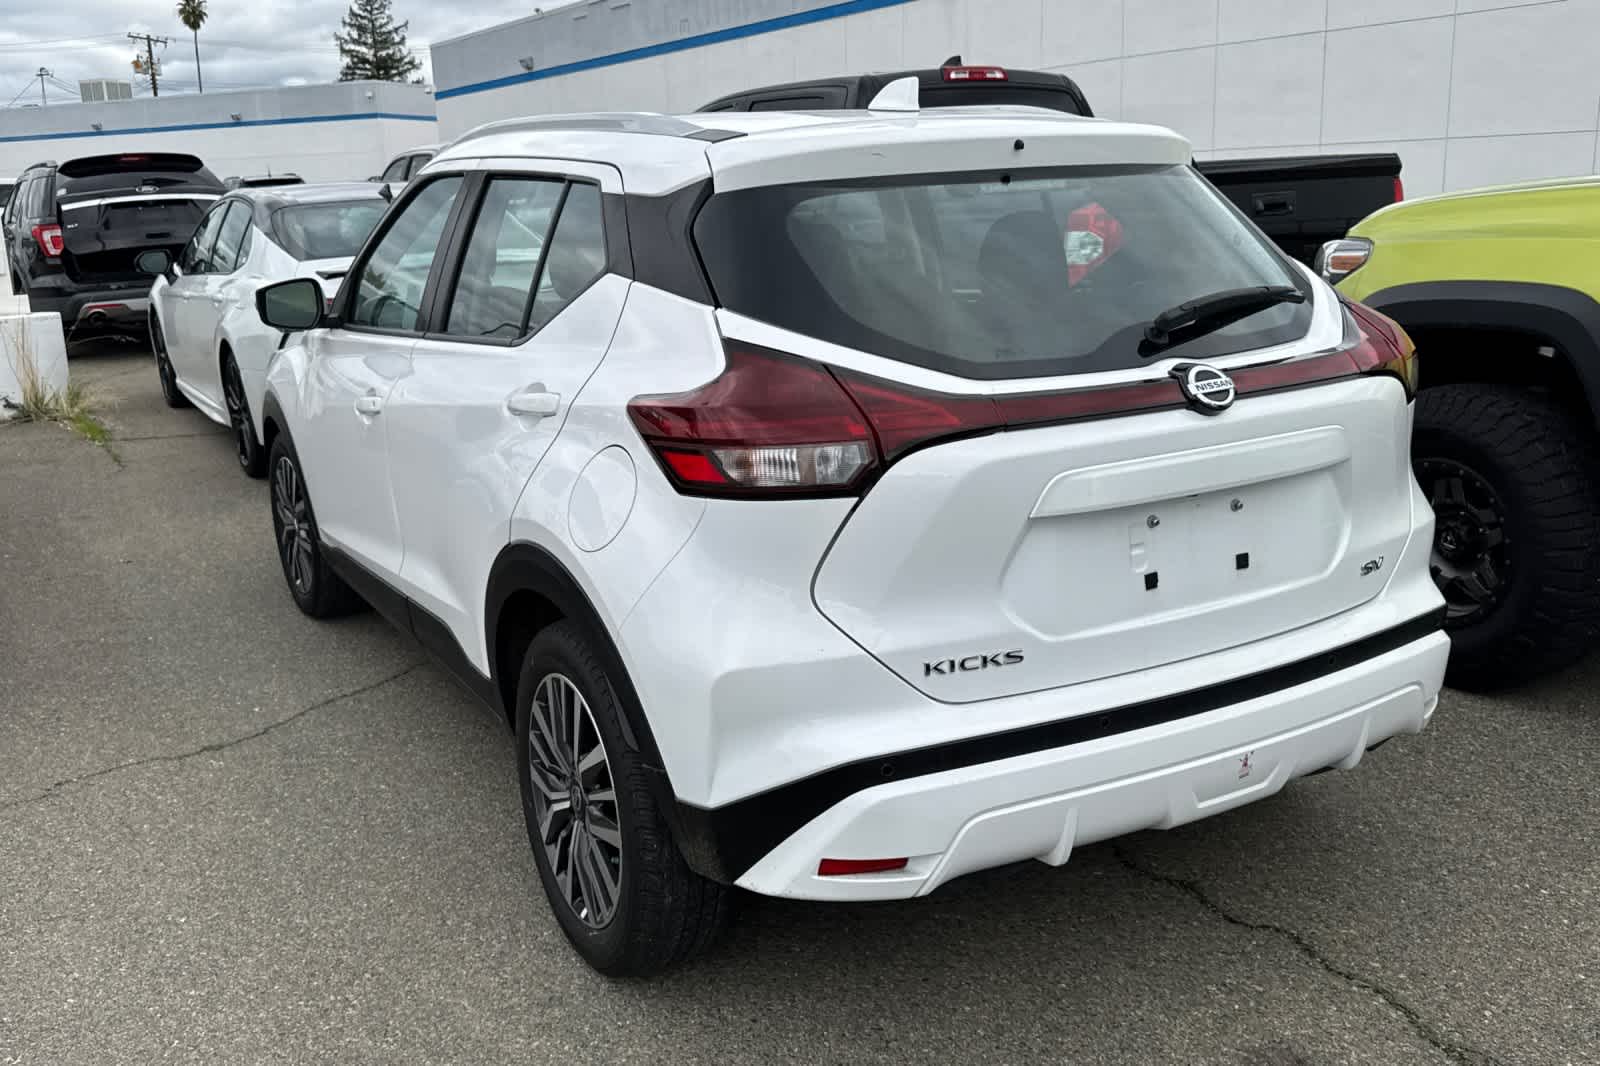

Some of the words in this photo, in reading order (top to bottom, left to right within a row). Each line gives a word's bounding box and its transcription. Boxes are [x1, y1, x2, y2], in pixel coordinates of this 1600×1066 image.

[1195, 379, 1232, 391] NISSAN
[1360, 555, 1384, 576] SV
[923, 649, 1024, 677] KICKS
